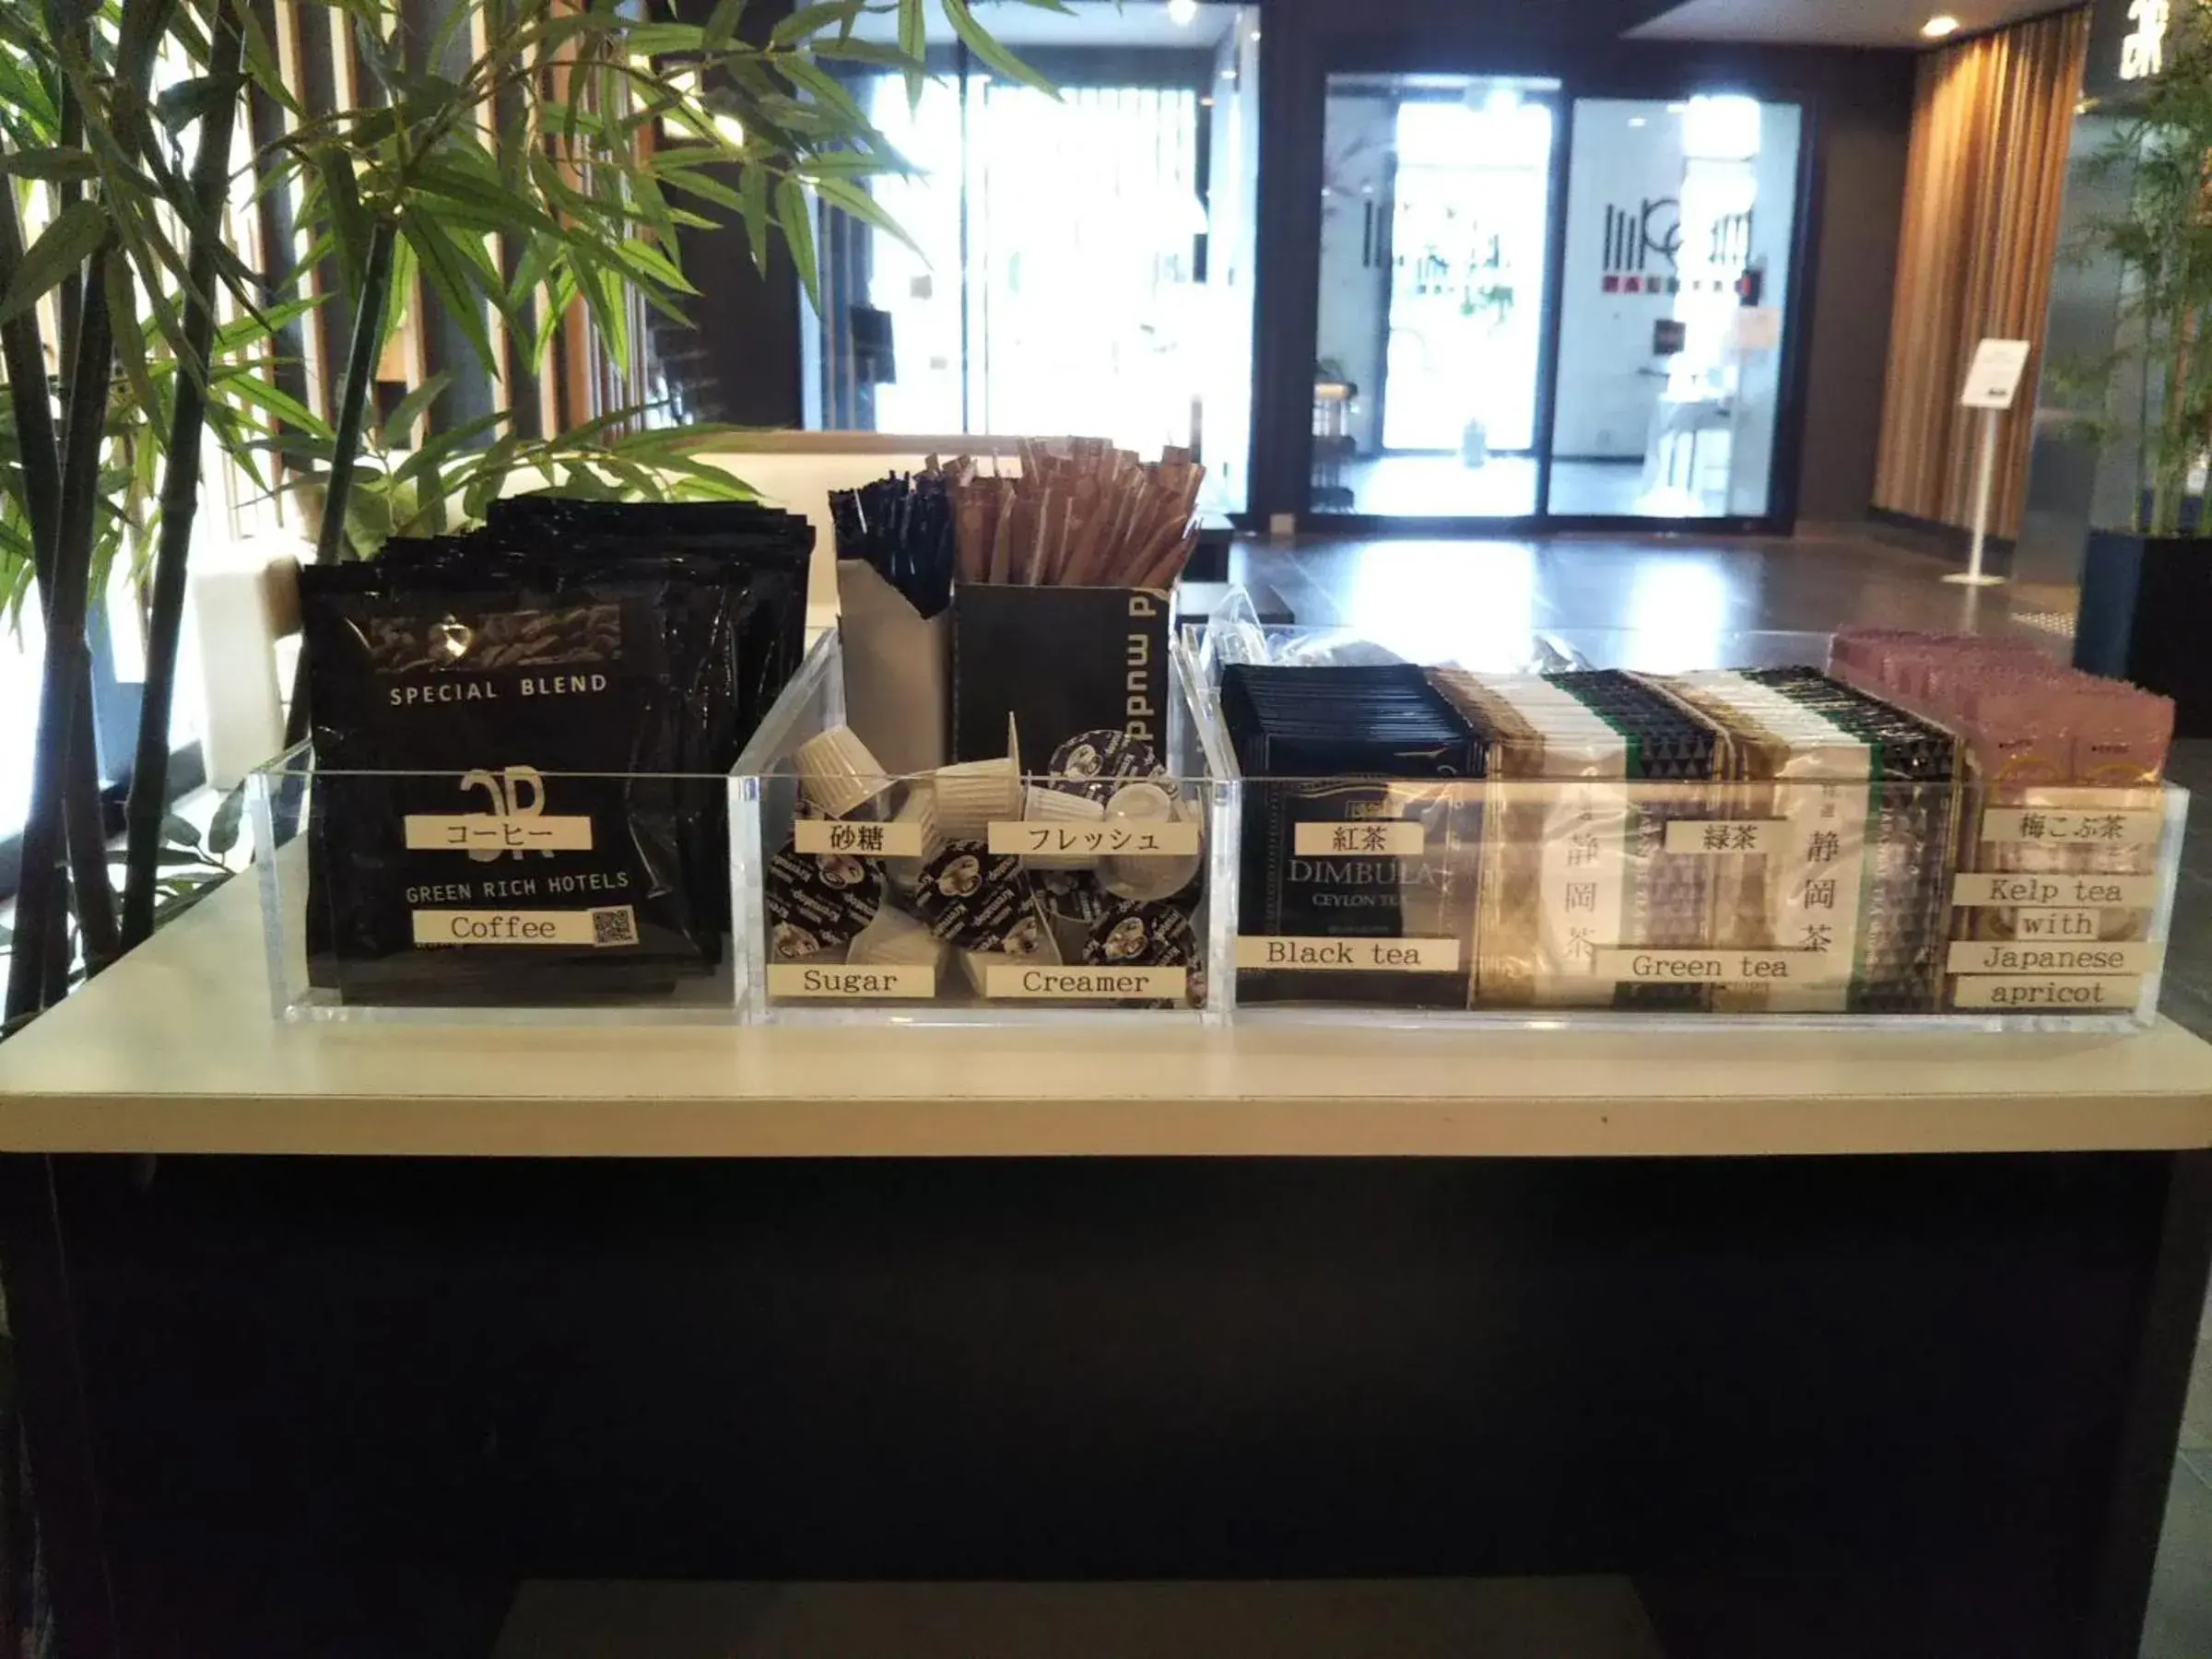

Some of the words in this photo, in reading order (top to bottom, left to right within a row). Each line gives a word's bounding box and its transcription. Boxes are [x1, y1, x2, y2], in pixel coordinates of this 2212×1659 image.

[390, 681, 498, 706] SPECIAL
[520, 674, 607, 696] BLEND
[447, 823, 553, 846] コーヒー
[829, 825, 885, 852] 砂糖
[1029, 828, 1160, 851] フレッシュ
[1332, 826, 1387, 852] 紅茶
[1703, 824, 1758, 850] 緑茶
[1287, 858, 1436, 886] DIMBULA
[406, 883, 472, 904] GREEN
[483, 877, 536, 898] RICH
[548, 871, 629, 894] HOTELS
[1799, 830, 1840, 953] 静岡茶
[1990, 878, 2059, 904] Kelp
[2071, 880, 2123, 902] tea
[1312, 893, 1375, 908] CEYLON
[451, 916, 556, 938] Coffee
[2022, 912, 2093, 935] with
[1266, 941, 1355, 964] Black
[1373, 943, 1421, 965] tea
[1983, 946, 2124, 971] Japanese
[1632, 955, 1723, 977] Green
[1739, 956, 1789, 978] tea
[803, 969, 899, 994] Sugar
[1022, 971, 1149, 993] Creamer
[1991, 982, 2105, 1005] apricot
